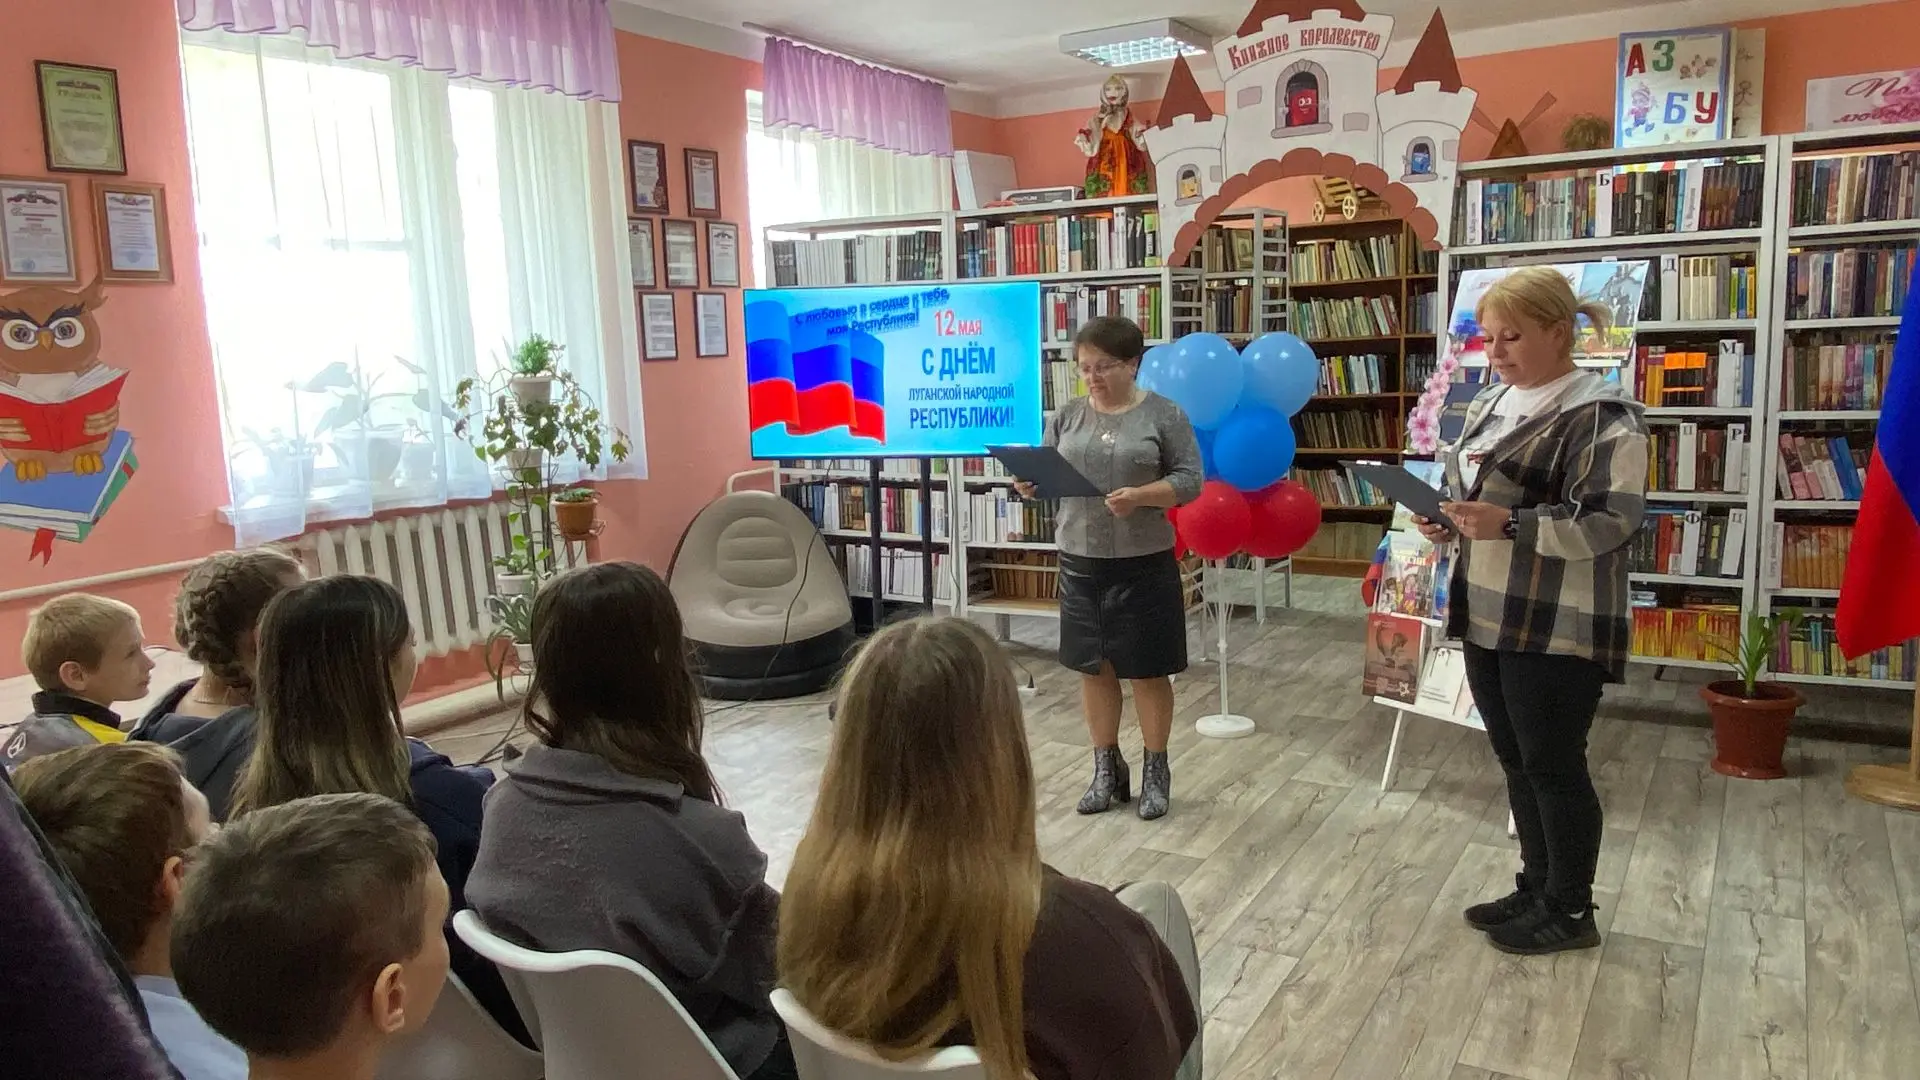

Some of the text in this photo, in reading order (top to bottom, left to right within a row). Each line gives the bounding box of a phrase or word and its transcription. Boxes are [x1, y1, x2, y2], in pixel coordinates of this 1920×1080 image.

[1227, 27, 1381, 70] Книжное королевство
[1599, 173, 1611, 187] Б
[1662, 257, 1677, 274] Д
[806, 304, 858, 323] любовью
[934, 308, 982, 336] 12 МАЯ
[1720, 341, 1737, 354] М
[921, 340, 996, 381] С ДНЁМ
[908, 383, 1015, 402] ЛУГАНСКОЙ НАРОДНОЙ
[909, 404, 1016, 430] РЕСПУБЛИКИ!
[1731, 427, 1742, 441] Р
[1685, 512, 1700, 525] Ф
